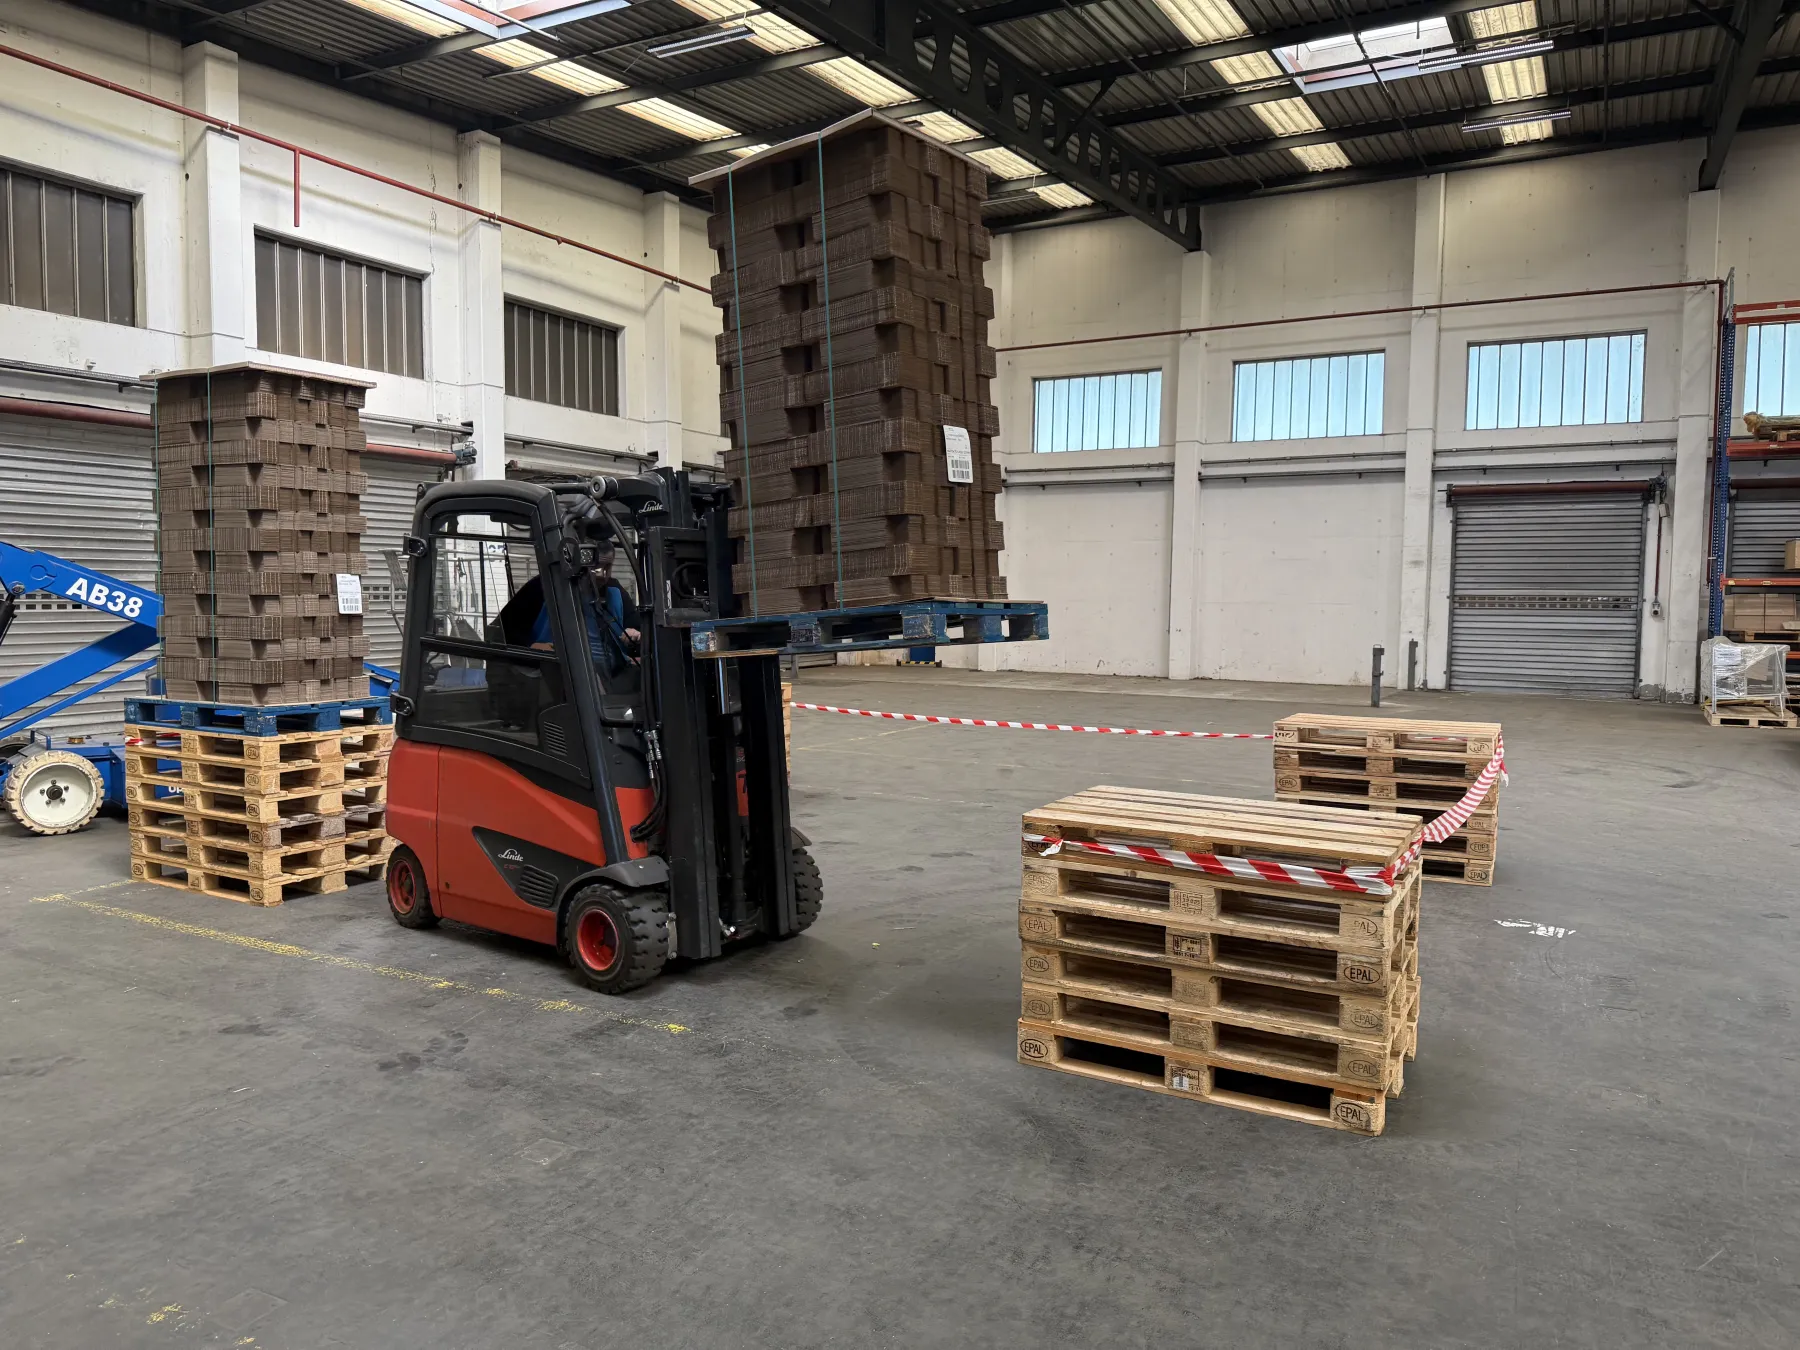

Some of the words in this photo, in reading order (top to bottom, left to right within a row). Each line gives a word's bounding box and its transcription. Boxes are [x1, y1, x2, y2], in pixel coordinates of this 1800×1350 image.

[639, 500, 664, 513] Linde
[65, 577, 143, 618] AB38
[497, 848, 524, 861] Linde
[1028, 919, 1048, 931] EPAL
[1029, 959, 1046, 970] EPAL
[1349, 967, 1374, 982] EPAL
[1031, 1003, 1047, 1013] EPAL
[1353, 1015, 1375, 1026] EPAL
[1024, 1044, 1044, 1056] EPAL
[1352, 1062, 1373, 1075] EPAL
[1340, 1105, 1363, 1122] EPAL
